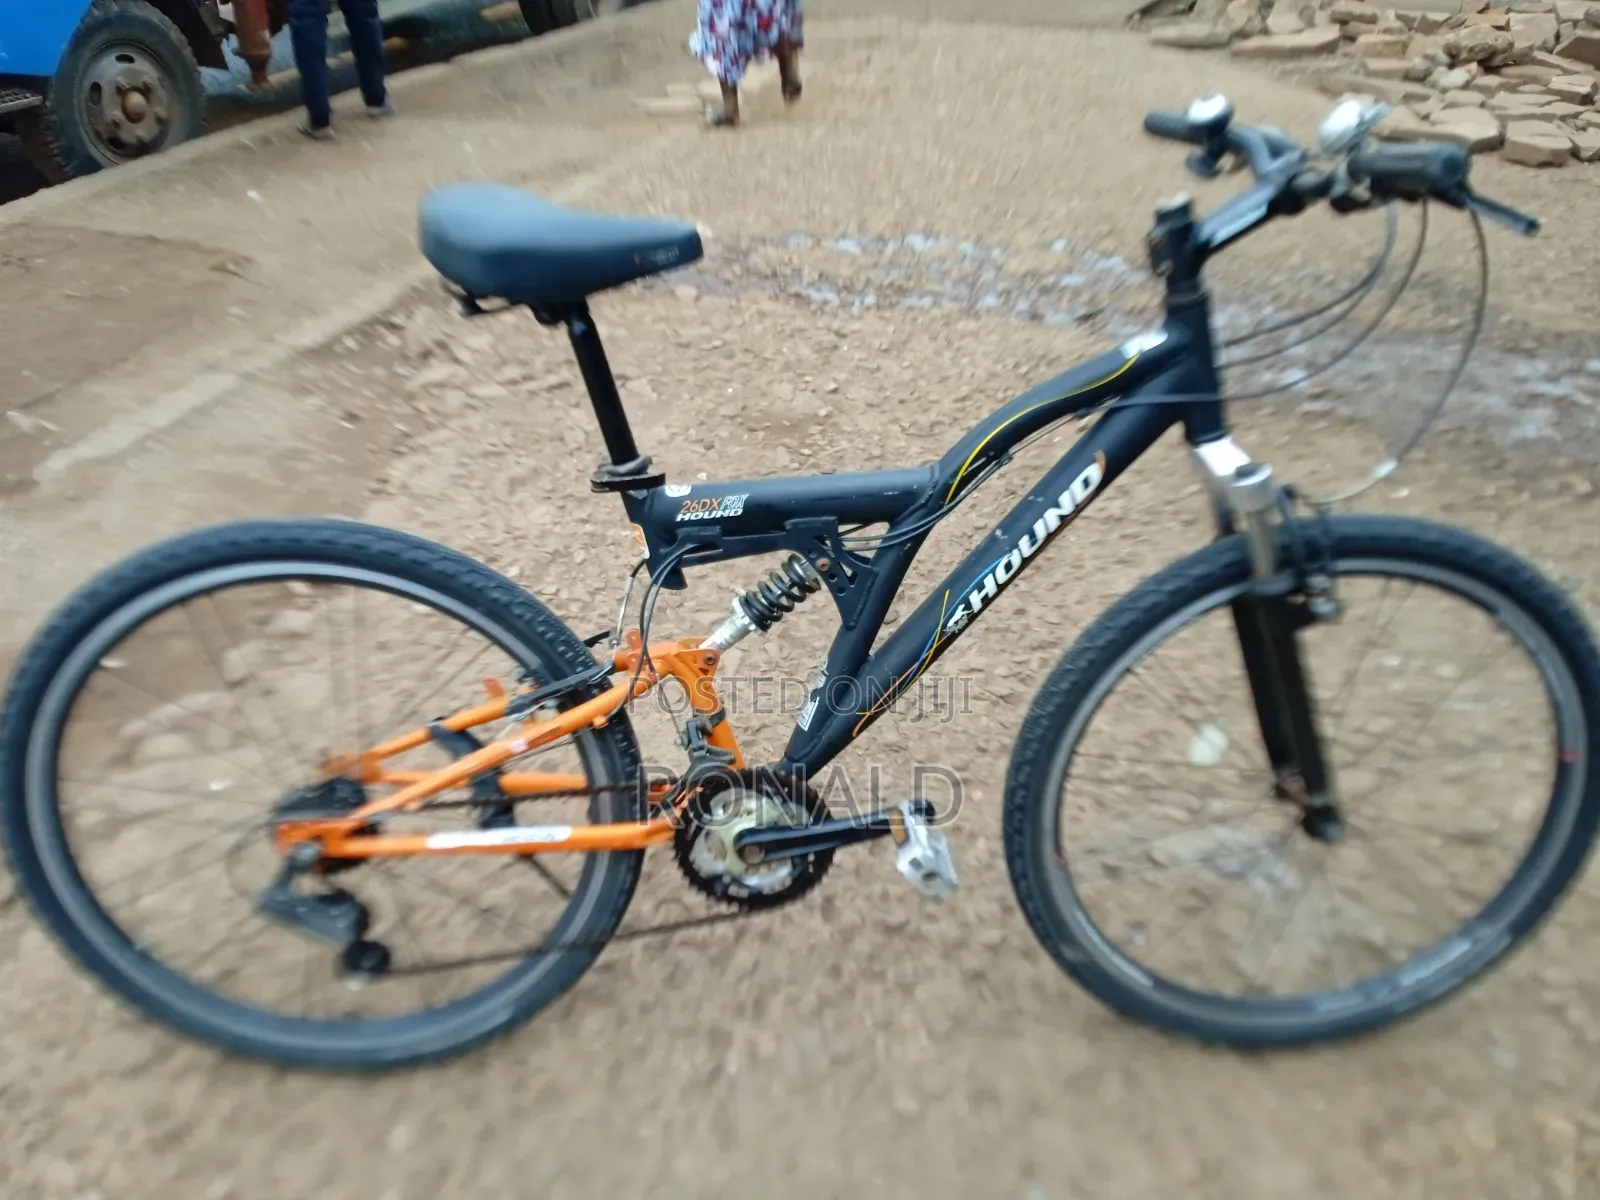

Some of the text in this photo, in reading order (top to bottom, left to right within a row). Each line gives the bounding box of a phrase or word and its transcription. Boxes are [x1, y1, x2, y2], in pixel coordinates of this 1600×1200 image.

[680, 498, 721, 513] 26DX
[676, 508, 743, 521] HOUND
[968, 462, 1103, 614] HOUND
